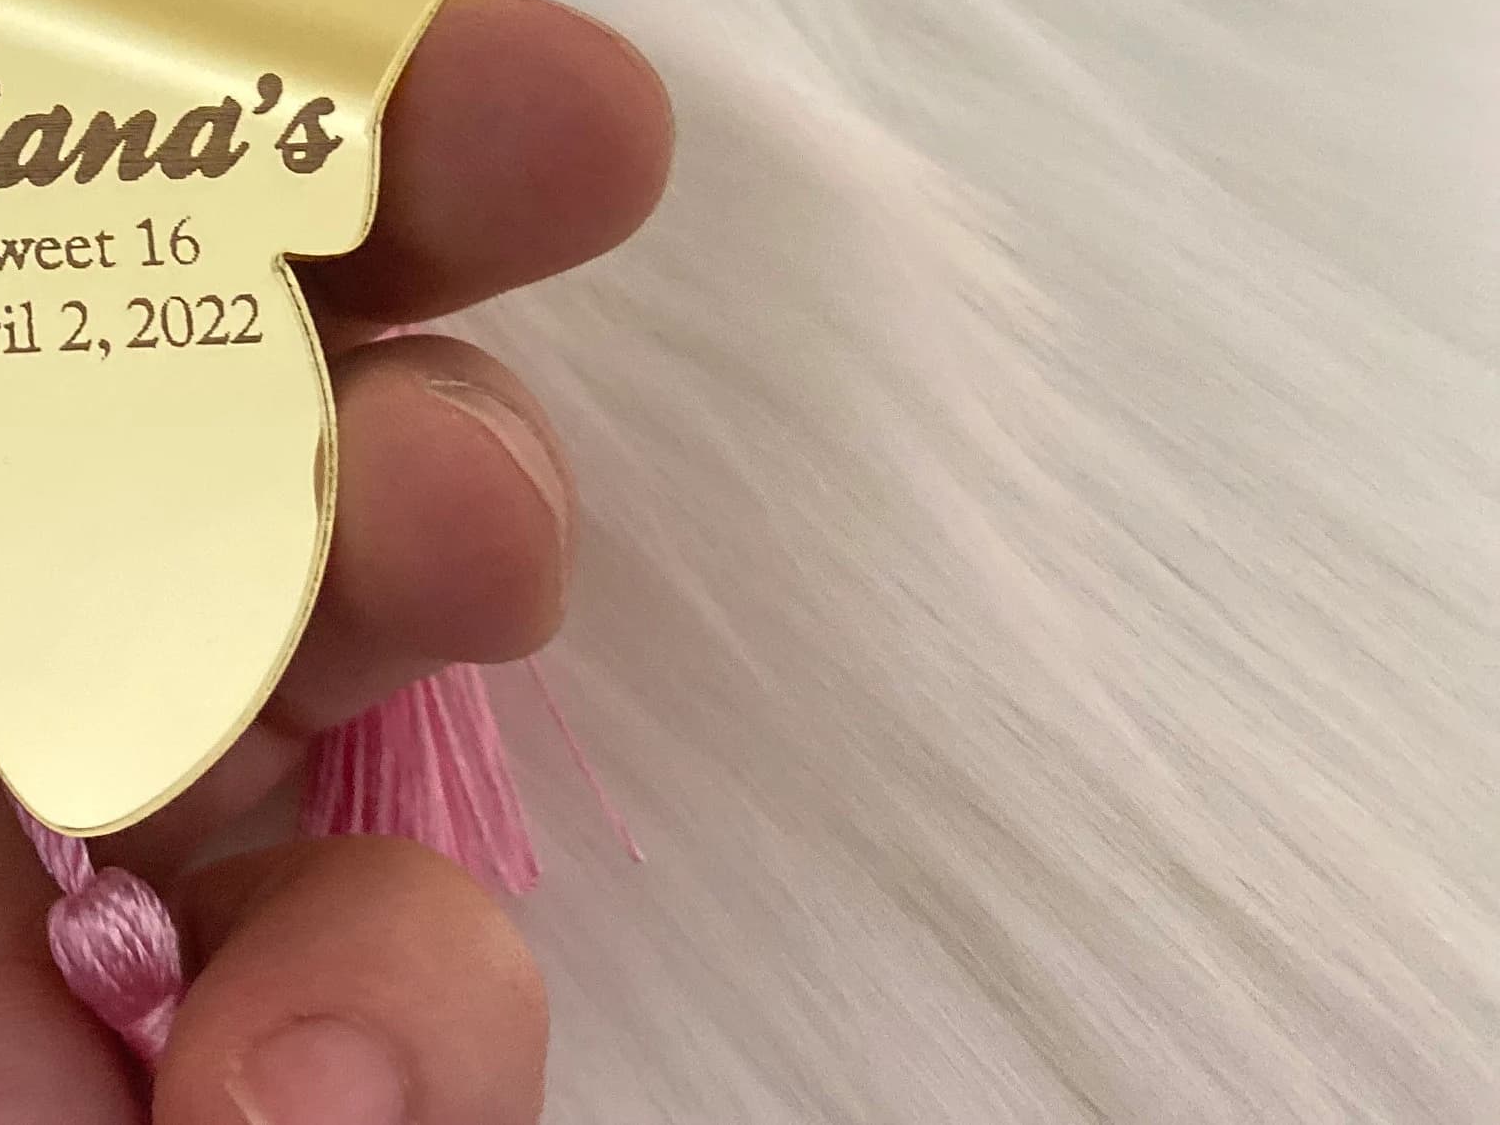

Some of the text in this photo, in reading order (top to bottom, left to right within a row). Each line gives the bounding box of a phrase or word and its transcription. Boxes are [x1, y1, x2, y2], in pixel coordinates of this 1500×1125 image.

[136, 216, 201, 267] 16
[59, 300, 112, 361] 2,
[126, 293, 264, 350] 2022
